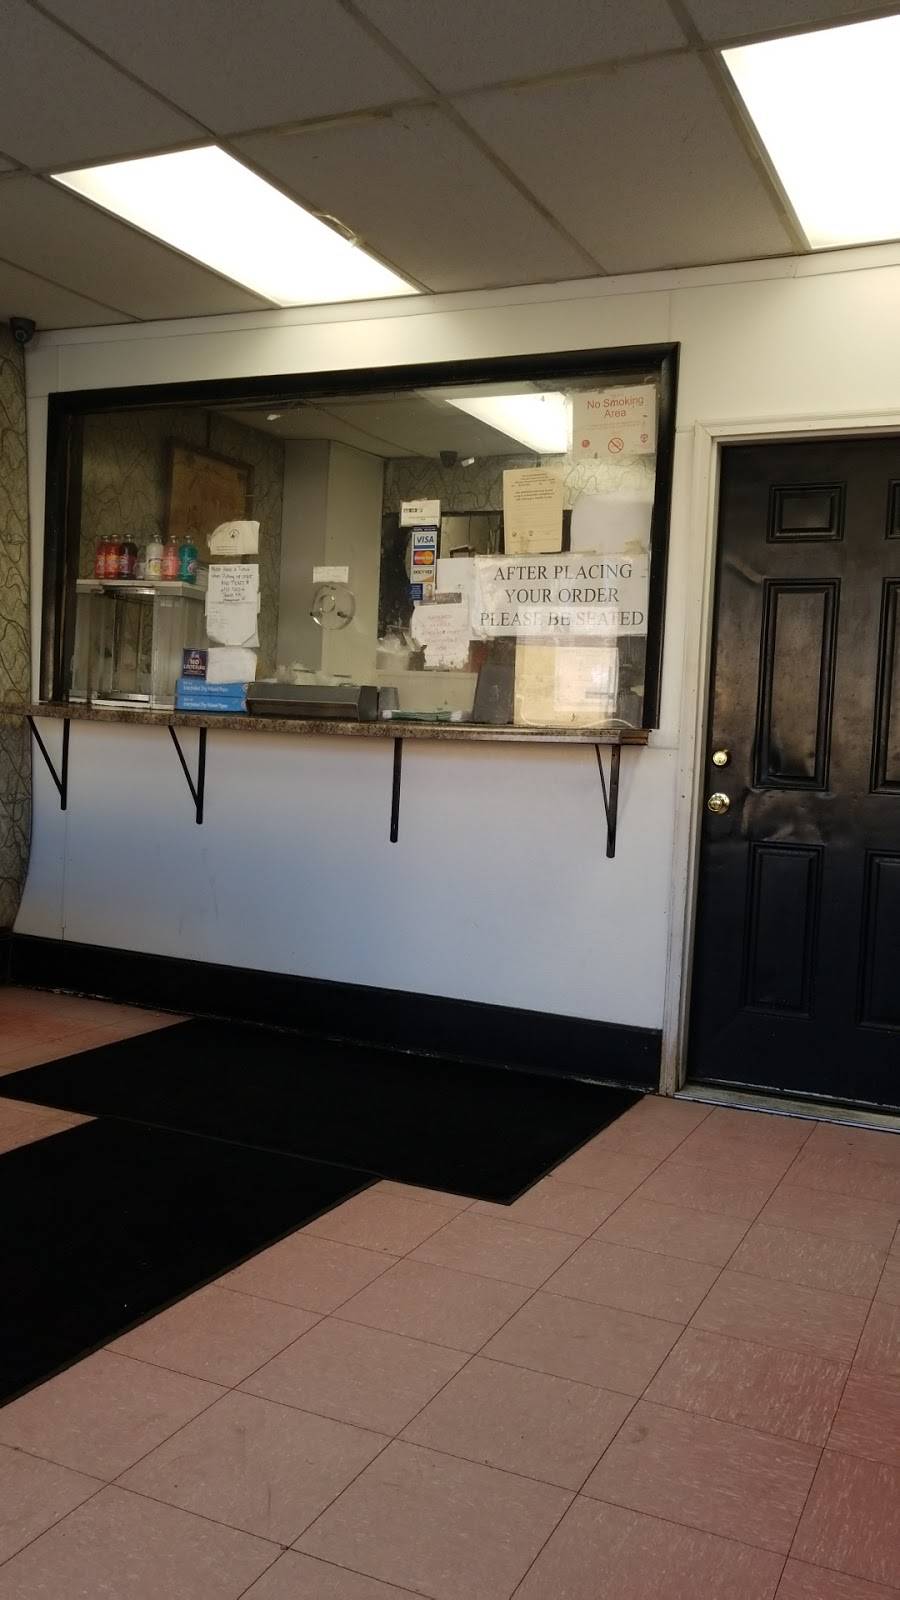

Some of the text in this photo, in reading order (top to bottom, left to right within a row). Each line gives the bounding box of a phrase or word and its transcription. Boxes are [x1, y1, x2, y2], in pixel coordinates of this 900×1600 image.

[587, 396, 644, 409] No Smoking
[605, 409, 627, 418] Area
[416, 535, 435, 544] VISA
[494, 563, 633, 581] AFTER PLACING
[504, 587, 620, 604] YOUR ORDER
[480, 610, 644, 627] PLEASE BE SEATED
